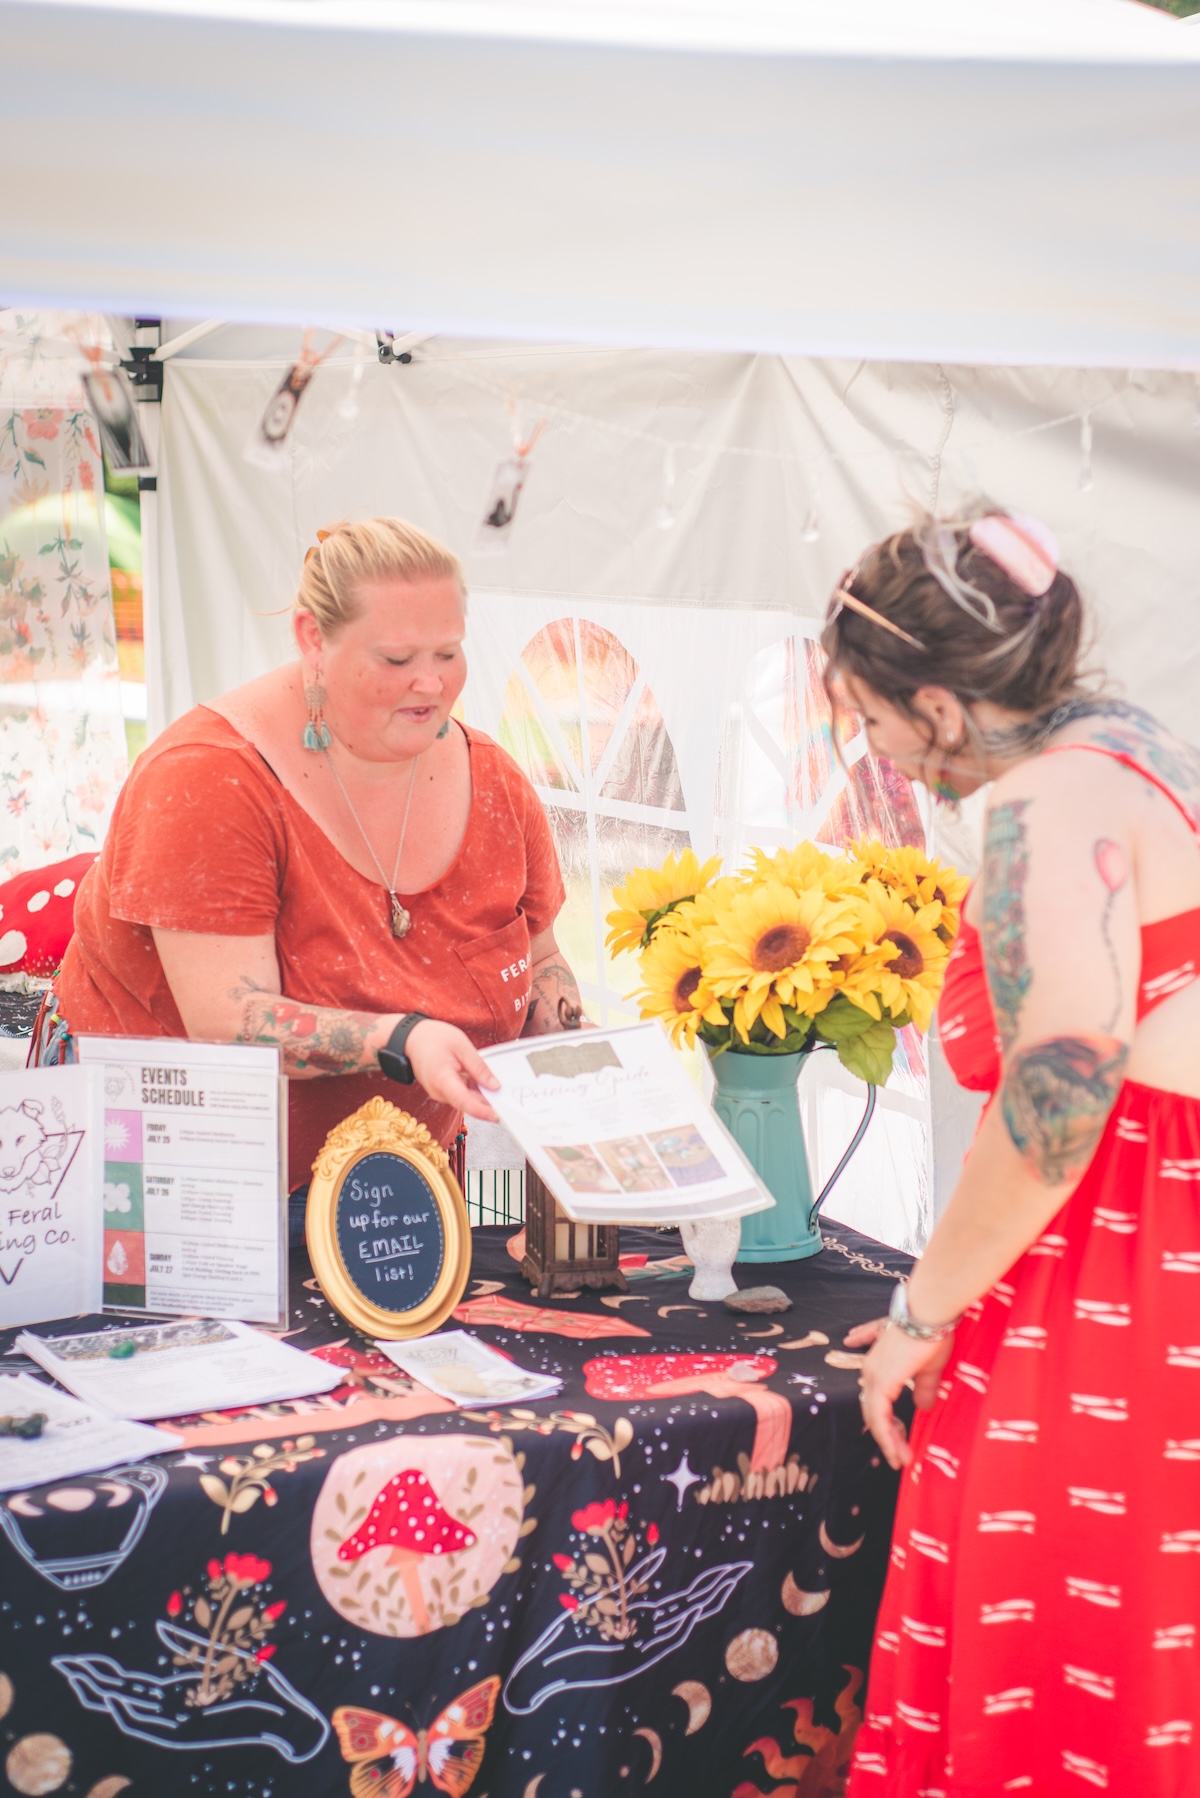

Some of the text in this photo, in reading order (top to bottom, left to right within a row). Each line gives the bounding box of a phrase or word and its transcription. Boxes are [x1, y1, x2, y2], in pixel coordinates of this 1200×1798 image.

[141, 1067, 187, 1086] EVENTS
[141, 1087, 205, 1107] SCHEDULE
[146, 1123, 167, 1132] FRIDAY
[147, 1135, 161, 1144] JULY
[162, 1136, 171, 1144] 25
[145, 1176, 175, 1185] SATURDAY
[146, 1188, 169, 1197] JULY 26
[350, 1178, 394, 1208] Sign
[8, 1202, 62, 1226] Feral
[350, 1209, 430, 1232] up for our
[44, 1229, 76, 1245] Co.
[358, 1234, 424, 1260] EMAIL
[149, 1253, 172, 1262] SUNDAY
[149, 1265, 173, 1274] JULY 27
[374, 1263, 414, 1282] list!
